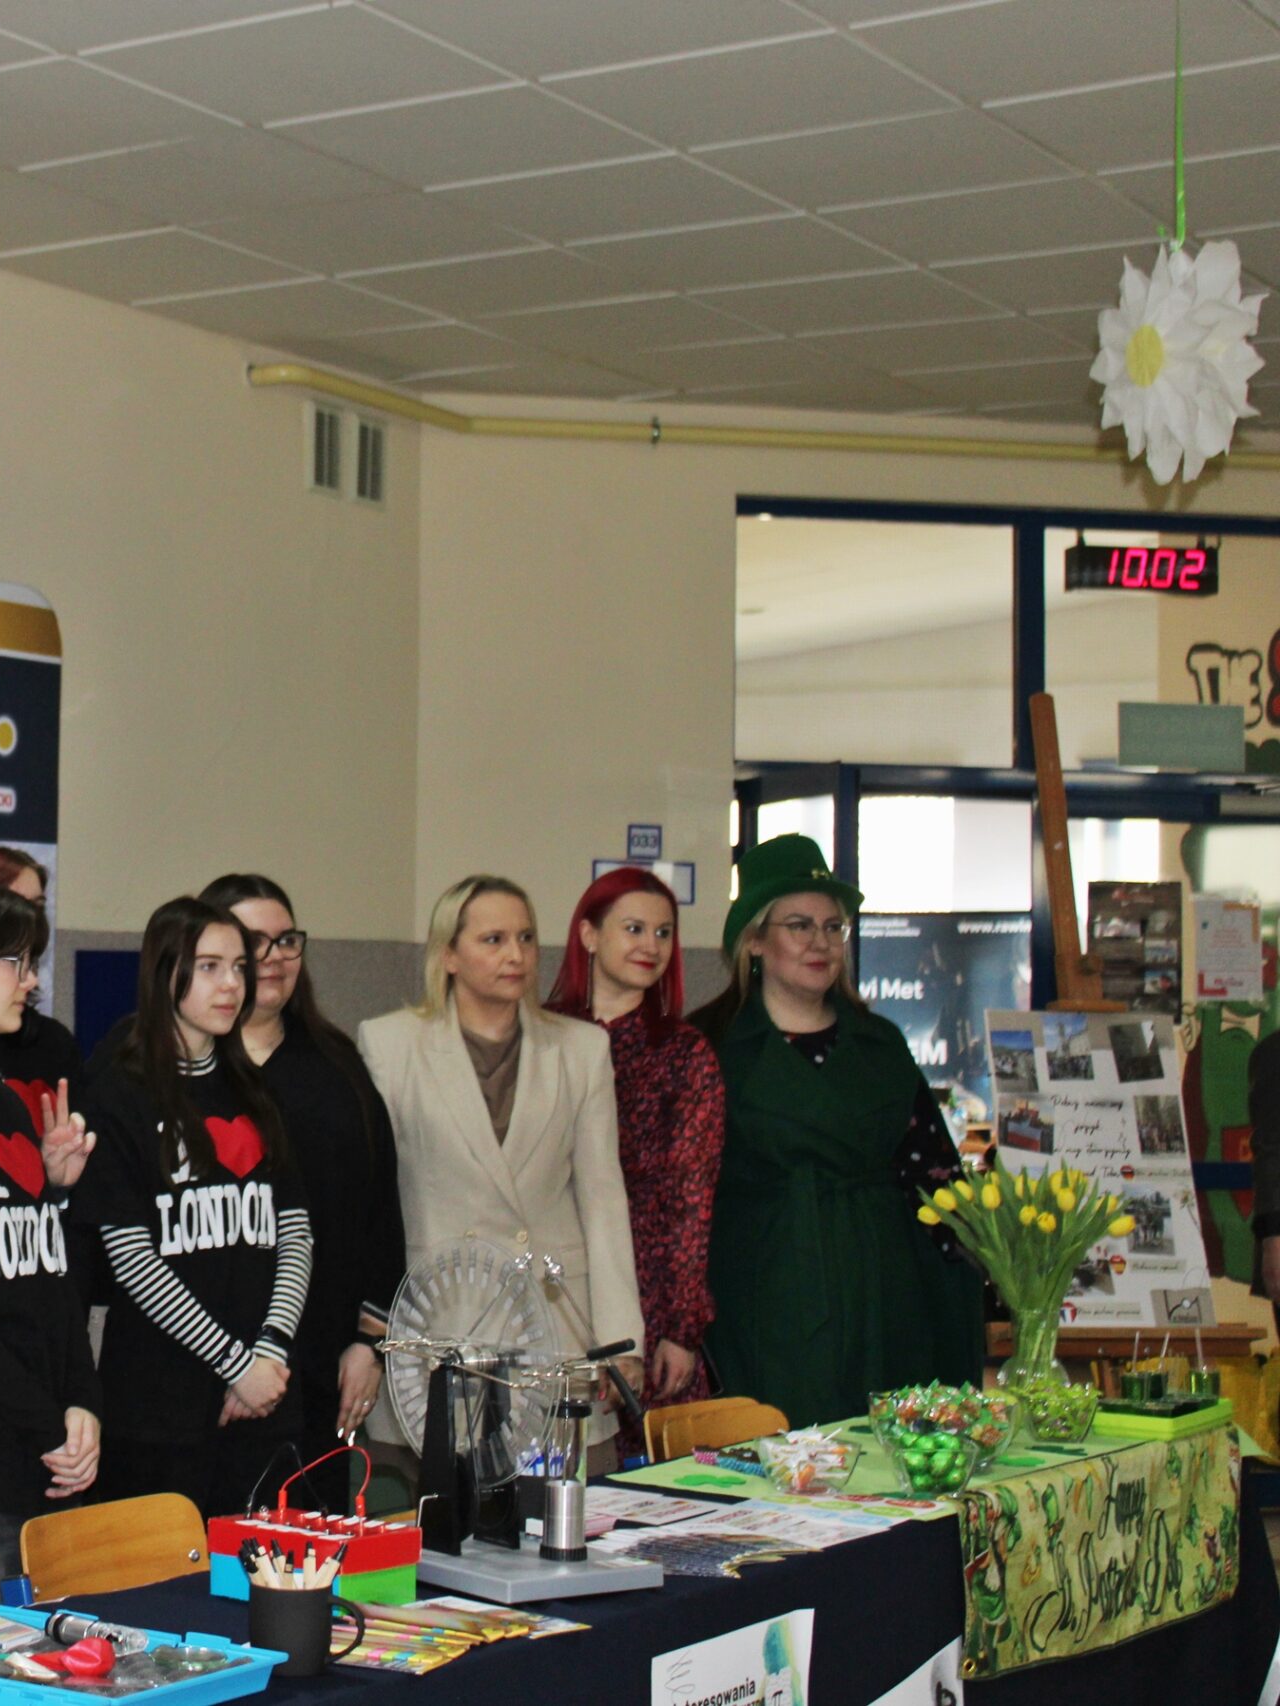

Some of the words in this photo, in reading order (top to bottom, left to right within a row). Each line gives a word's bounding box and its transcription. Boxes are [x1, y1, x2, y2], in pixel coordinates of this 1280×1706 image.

[1107, 546, 1207, 591] 10.02
[880, 977, 925, 1001] Met
[155, 1180, 277, 1257] LONDON
